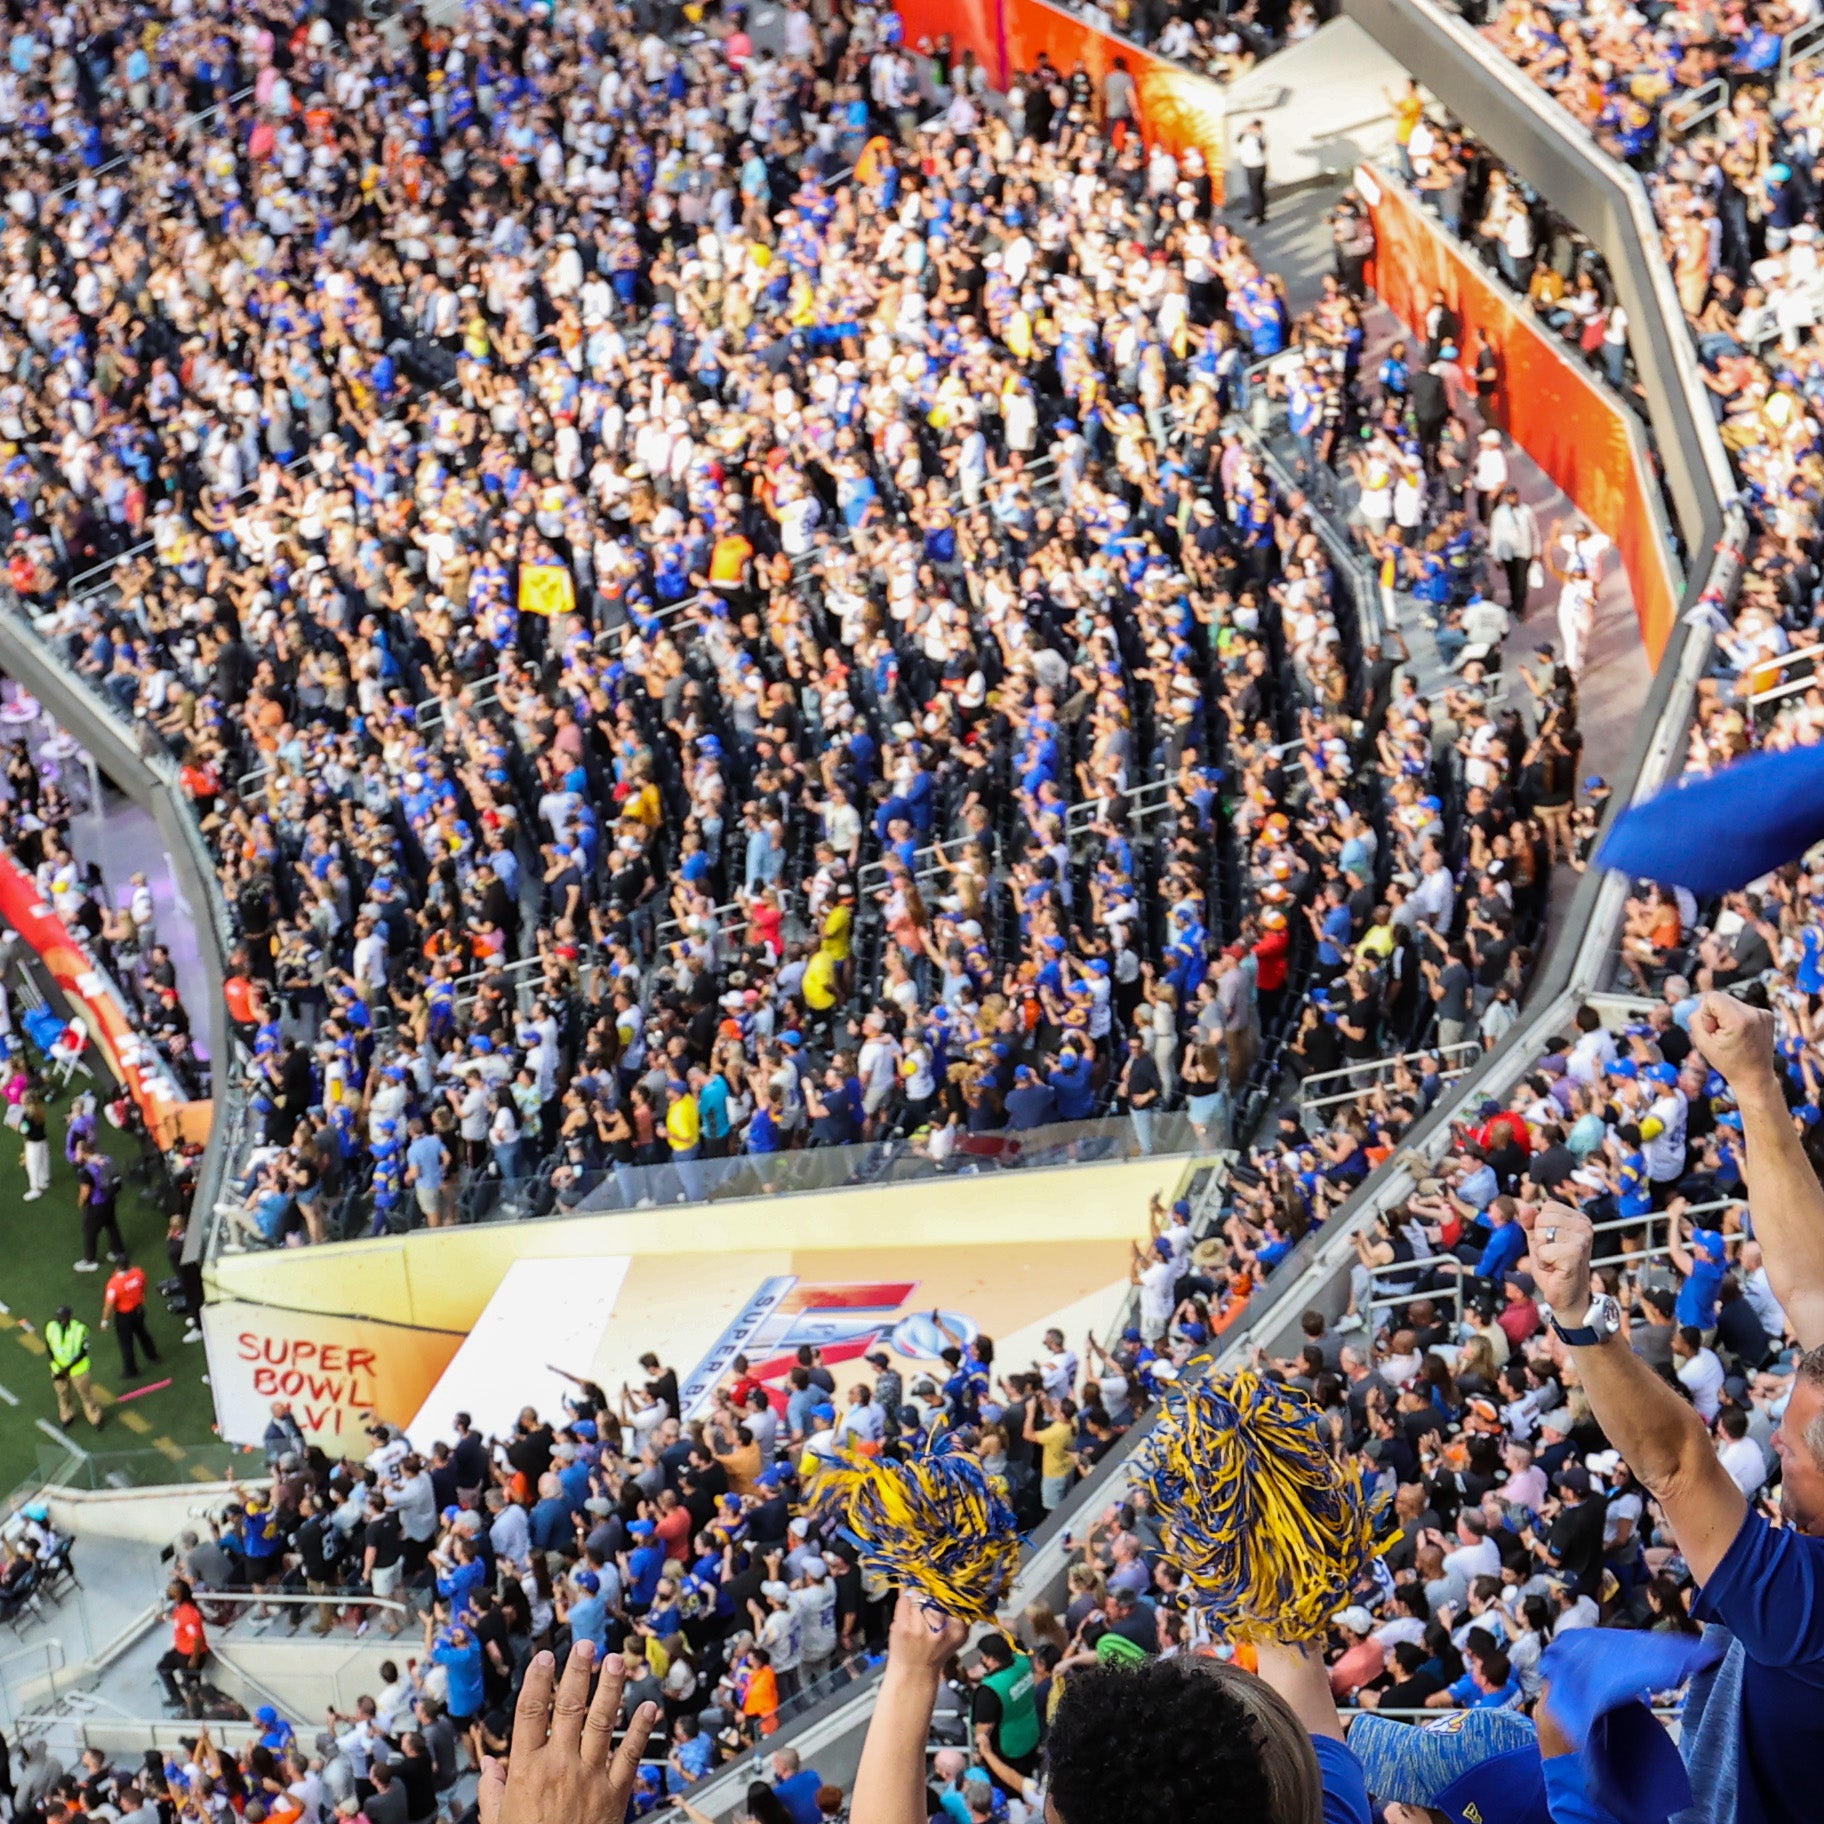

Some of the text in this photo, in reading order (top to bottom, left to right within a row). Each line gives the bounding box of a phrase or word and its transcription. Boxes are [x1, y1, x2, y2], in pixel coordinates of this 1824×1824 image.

[238, 1331, 377, 1377] SUPER
[701, 1293, 775, 1374] SUPER
[253, 1367, 375, 1407] BOWL
